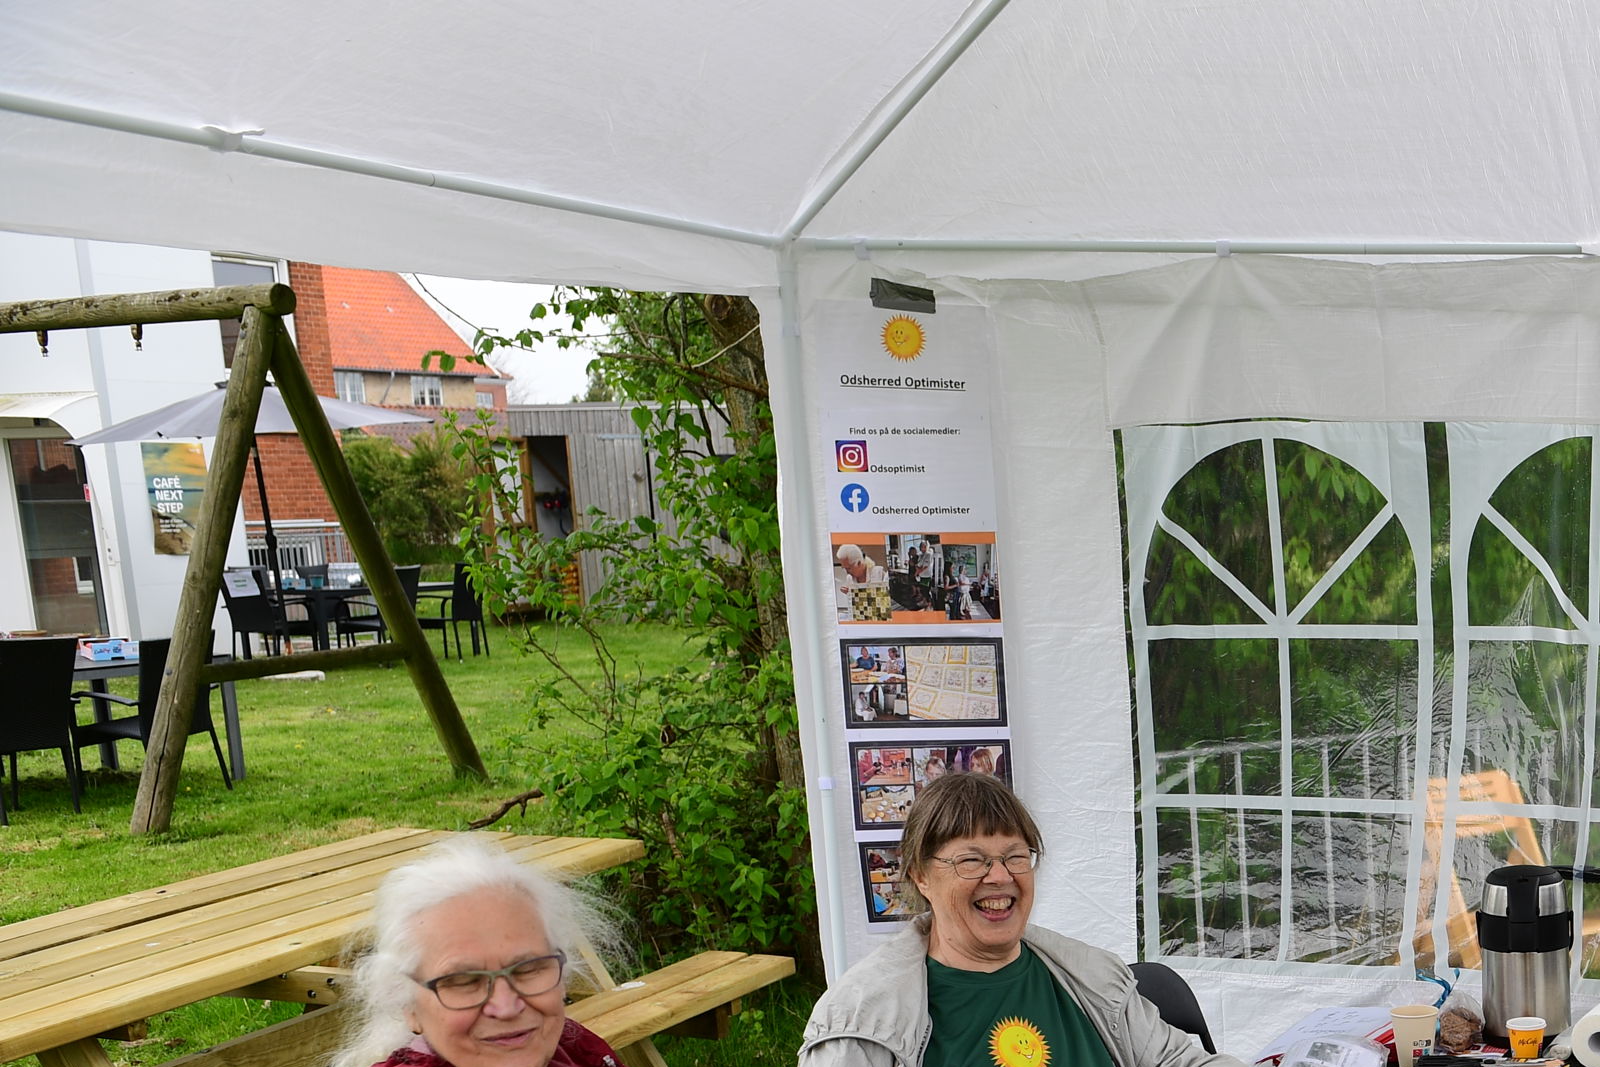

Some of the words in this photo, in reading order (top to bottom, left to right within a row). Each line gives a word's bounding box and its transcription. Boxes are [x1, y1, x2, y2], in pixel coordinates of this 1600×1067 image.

[840, 374, 901, 387] Odsherred
[904, 376, 966, 389] Optimister
[849, 427, 866, 435] Find
[879, 426, 889, 436] på
[891, 427, 901, 435] de
[870, 464, 925, 474] Odsoptimist
[153, 475, 181, 489] CAFÉ
[155, 490, 183, 501] NEXT
[157, 502, 184, 513] STEP
[872, 506, 919, 515] Odsherred
[922, 506, 970, 516] Optimister
